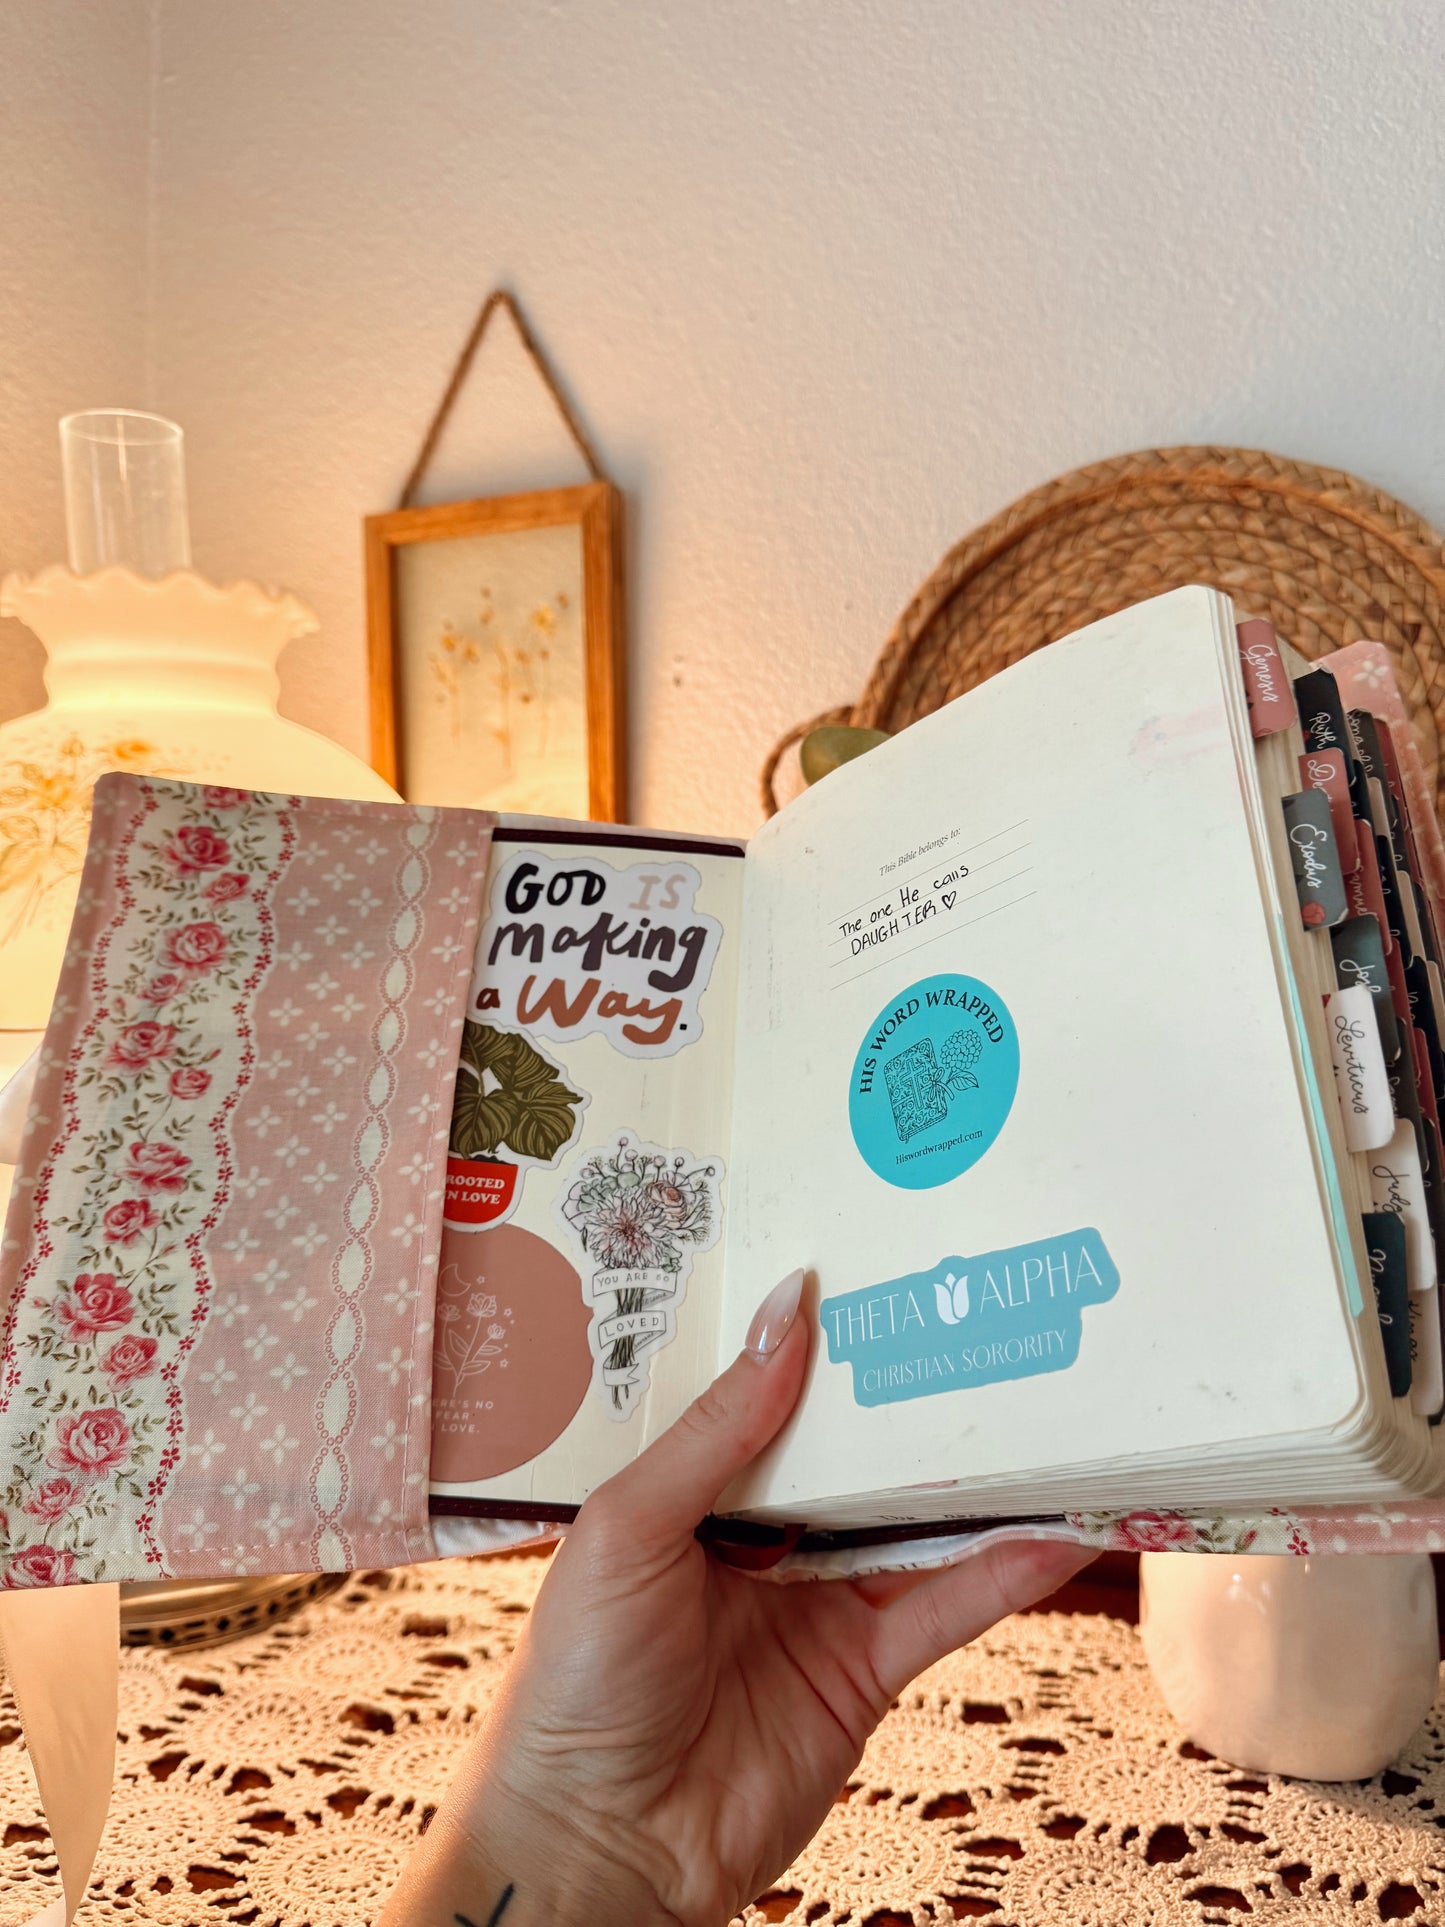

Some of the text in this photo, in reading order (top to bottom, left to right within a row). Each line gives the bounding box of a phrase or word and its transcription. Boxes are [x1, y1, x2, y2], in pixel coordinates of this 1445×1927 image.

[1308, 712, 1337, 749] Ruth
[878, 827, 962, 877] This Bible belongs to:
[1290, 823, 1328, 889] Exodus
[505, 862, 688, 914] GOD IS
[838, 865, 969, 937] The one He calls
[475, 987, 500, 1010] a
[859, 989, 1004, 1094] HIS WORD WRAPPED
[895, 1129, 983, 1165] Hiswordwrapped.com
[445, 1190, 501, 1205] N LOVE
[446, 1174, 505, 1190] ROOTED
[596, 1275, 619, 1288] YOU
[626, 1272, 648, 1282] ARE
[829, 1246, 1103, 1348] THETA ALPHA
[604, 1317, 659, 1337] LOVED
[863, 1328, 1067, 1393] CHRISTIAN SORORITY
[435, 1410, 470, 1421] FEAR
[475, 1400, 494, 1409] NO
[441, 1424, 480, 1433] LOVE.
